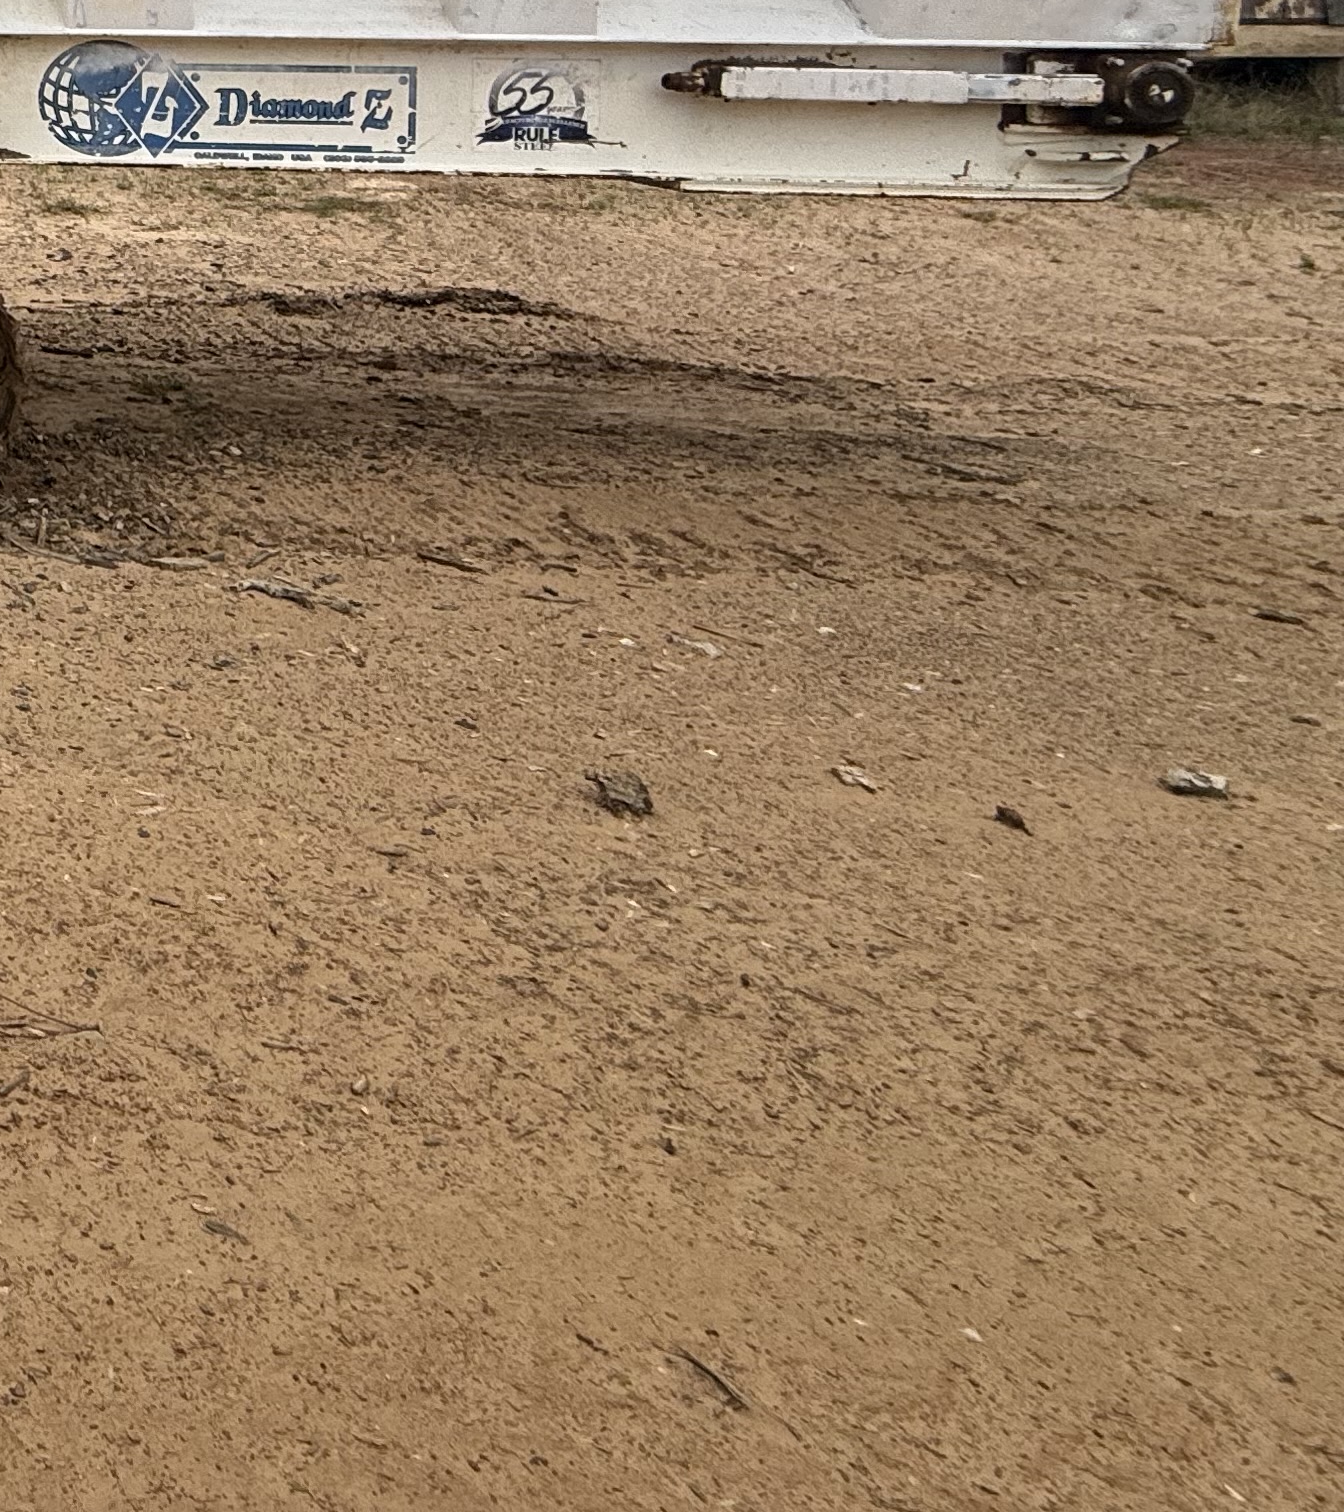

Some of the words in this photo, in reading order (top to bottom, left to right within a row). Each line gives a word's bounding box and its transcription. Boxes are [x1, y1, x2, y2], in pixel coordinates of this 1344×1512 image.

[214, 88, 357, 127] Diamond
[360, 88, 394, 134] Z
[514, 128, 558, 142] RULE
